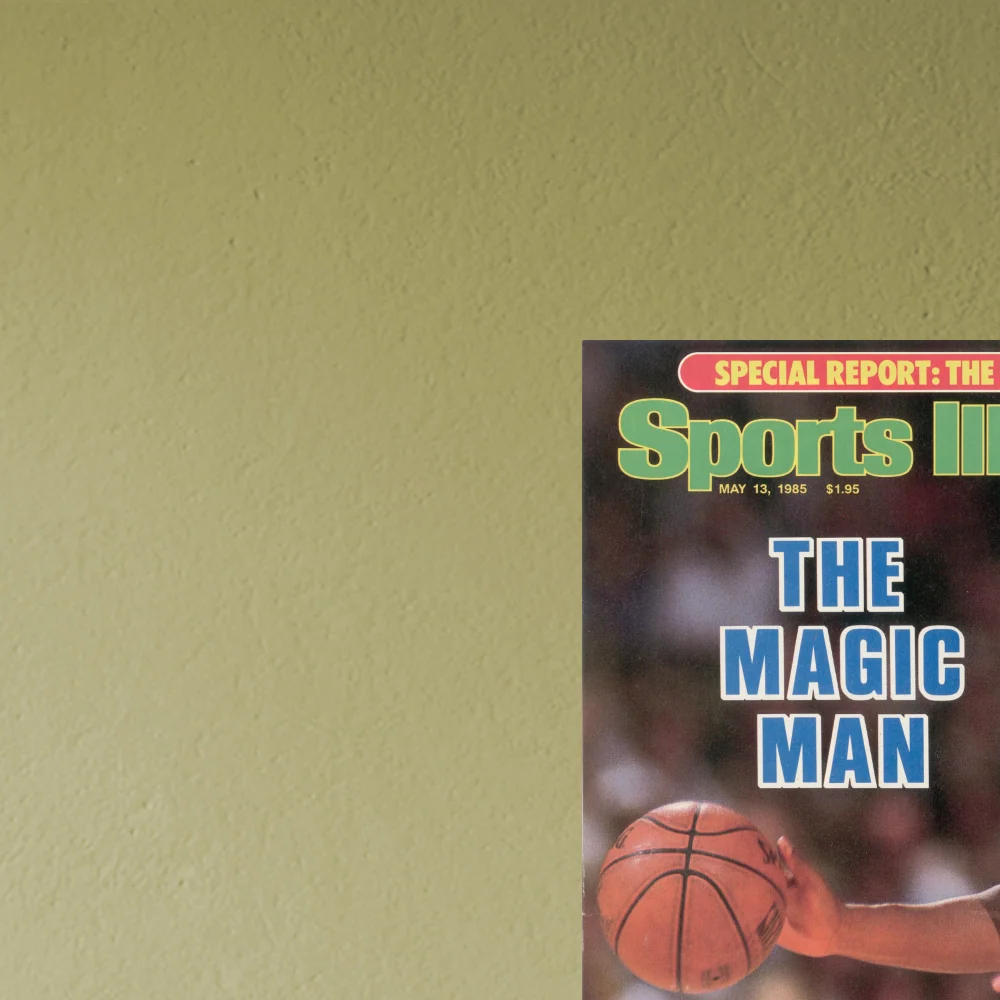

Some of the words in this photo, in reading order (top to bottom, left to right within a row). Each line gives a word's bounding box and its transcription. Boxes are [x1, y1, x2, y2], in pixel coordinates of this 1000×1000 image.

[714, 359, 820, 386] SPECIAL
[826, 359, 940, 386] REPORT:
[945, 360, 994, 386] THE
[617, 397, 914, 492] Sports
[719, 483, 746, 494] MAY
[753, 483, 771, 496] 13,
[777, 483, 807, 494] 1985
[825, 483, 860, 495] $1.95
[768, 537, 904, 613] THE
[720, 625, 965, 701] MAGIC
[757, 714, 929, 789] MAN
